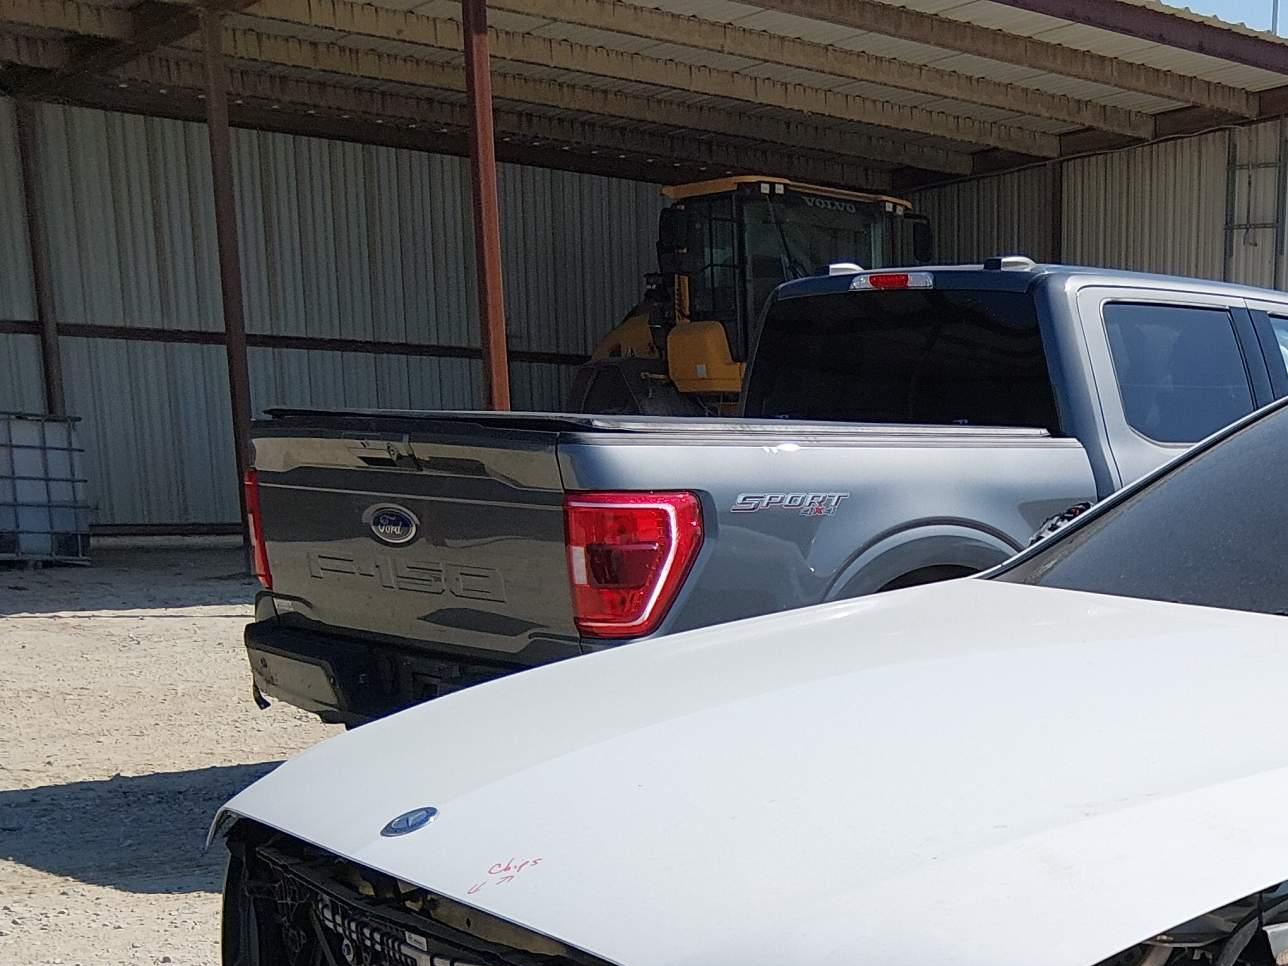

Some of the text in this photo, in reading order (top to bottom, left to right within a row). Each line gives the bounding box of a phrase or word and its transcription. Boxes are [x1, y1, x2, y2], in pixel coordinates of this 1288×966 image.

[801, 196, 857, 213] VOLVO
[730, 492, 850, 513] SPORT
[378, 513, 404, 535] Ford
[307, 551, 507, 603] F-150
[488, 858, 543, 875] Chips
